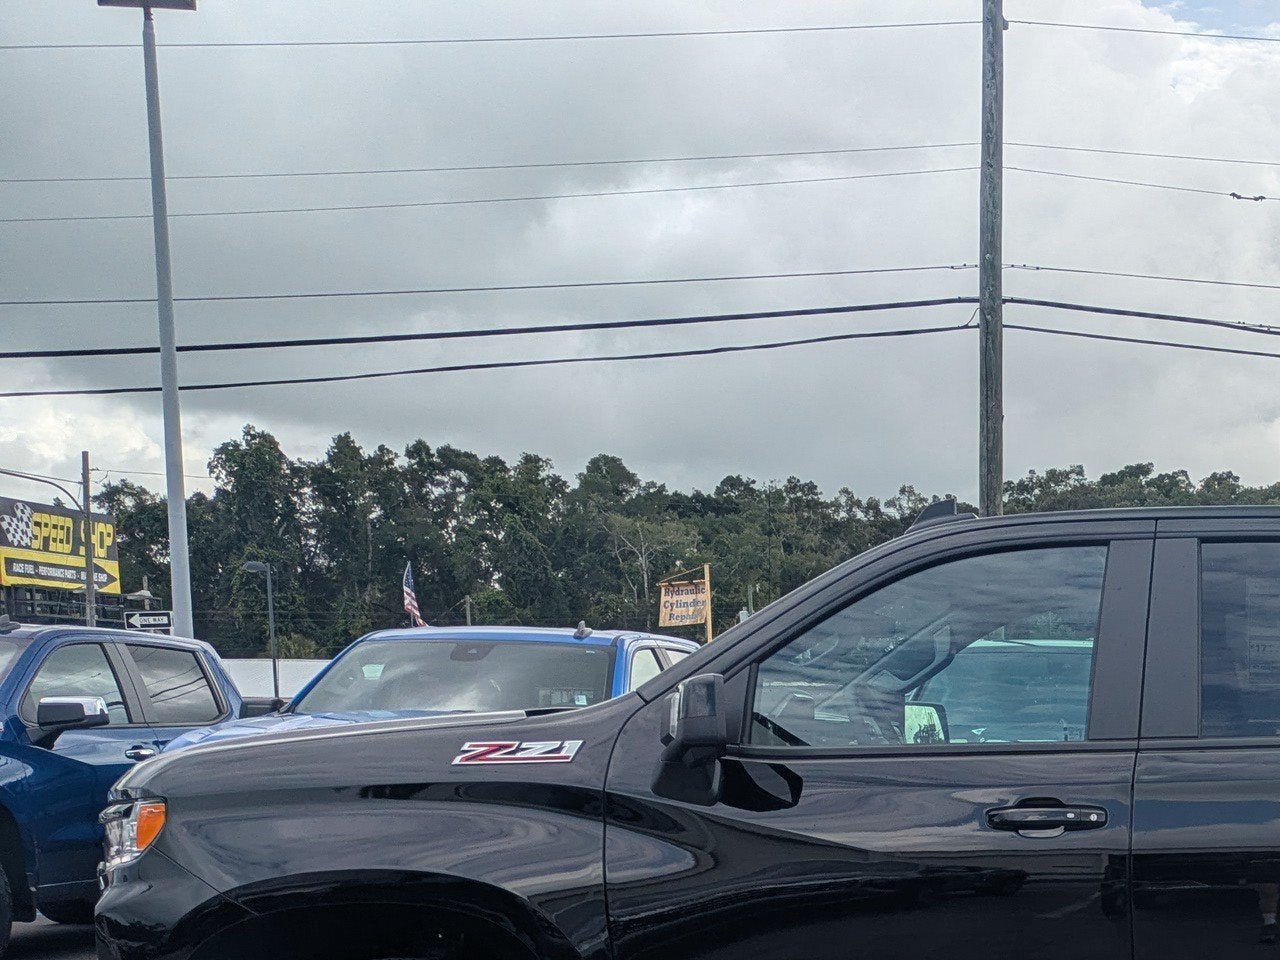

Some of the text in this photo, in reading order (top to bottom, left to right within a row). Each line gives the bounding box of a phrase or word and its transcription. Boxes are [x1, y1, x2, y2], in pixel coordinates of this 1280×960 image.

[32, 513, 73, 553] SPEED
[13, 563, 24, 572] RACE
[25, 564, 35, 574] FUEL
[38, 566, 64, 578] PERFORMANCE
[65, 568, 76, 579] PARTS
[664, 585, 706, 598] Hydraulic
[663, 599, 706, 611] Cylinder
[451, 740, 585, 765] Z71
